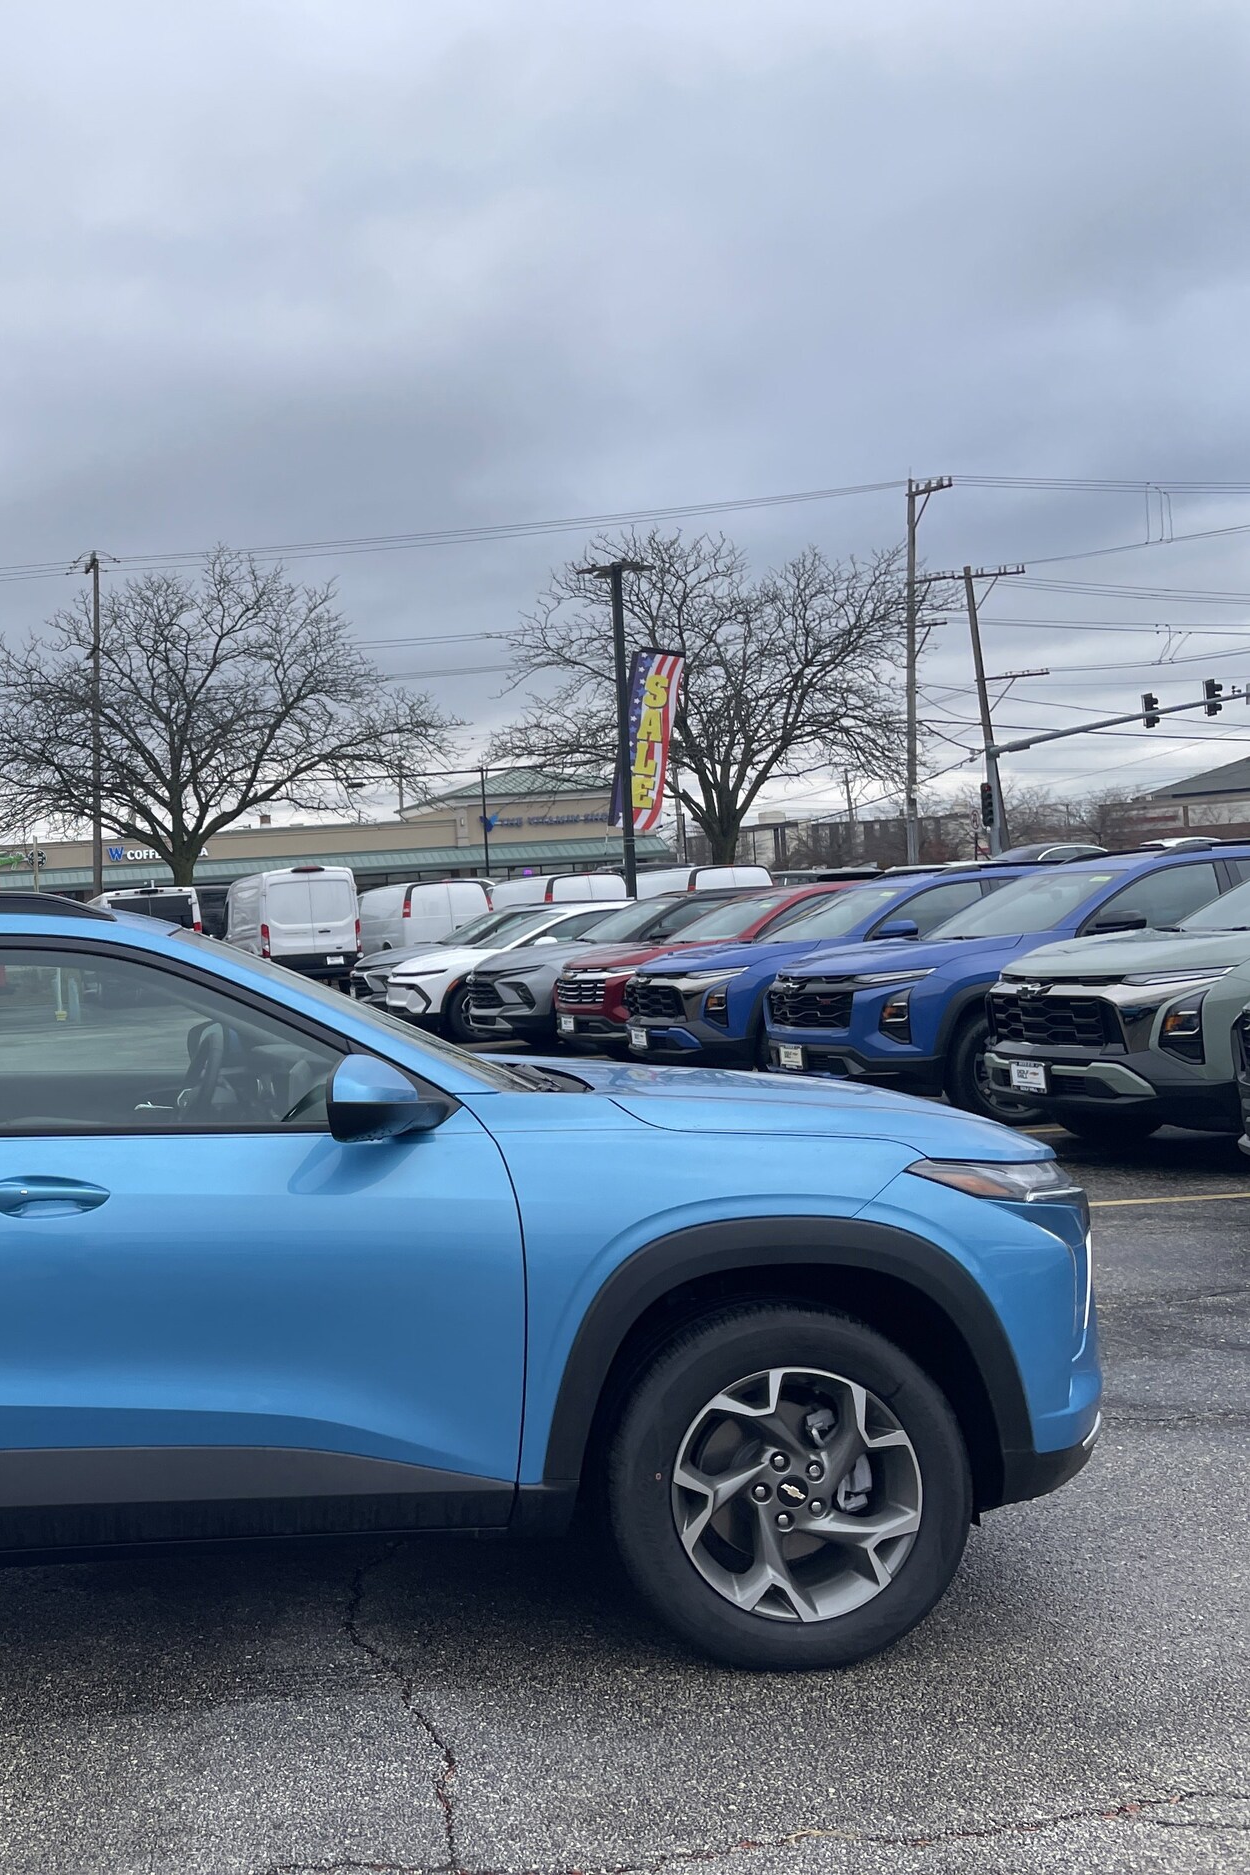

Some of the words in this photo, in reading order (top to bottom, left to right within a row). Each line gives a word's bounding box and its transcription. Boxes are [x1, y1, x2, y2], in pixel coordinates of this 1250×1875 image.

[632, 674, 669, 809] SALE
[107, 846, 125, 862] W
[126, 849, 162, 860] COFFE
